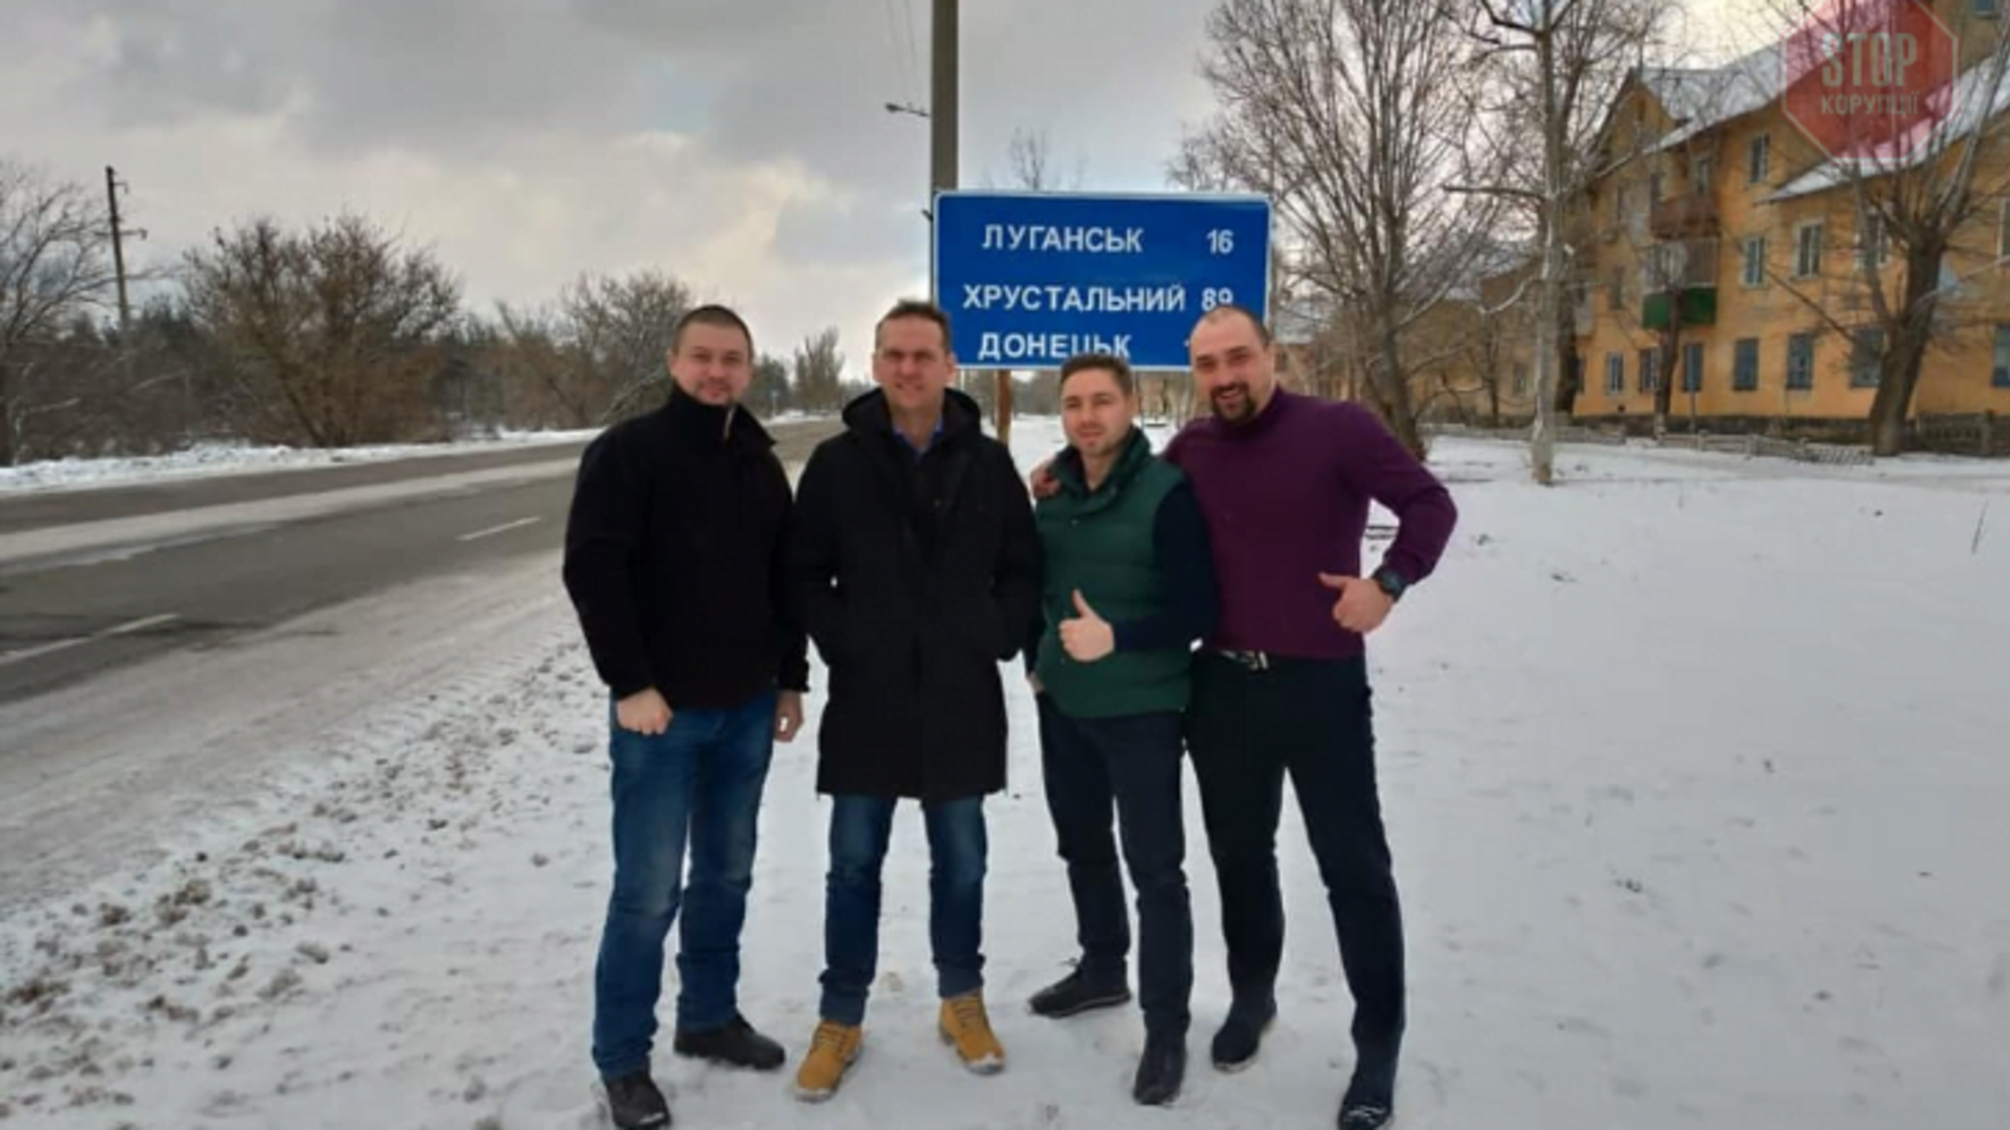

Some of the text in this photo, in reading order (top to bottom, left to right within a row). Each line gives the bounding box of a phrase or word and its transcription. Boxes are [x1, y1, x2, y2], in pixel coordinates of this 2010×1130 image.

[982, 224, 1234, 254] ЛУГАНСЬК 16
[962, 283, 1234, 312] ХРУСТАЛЬНИЙ 89
[977, 332, 1132, 361] ДОНЕЦЬК
